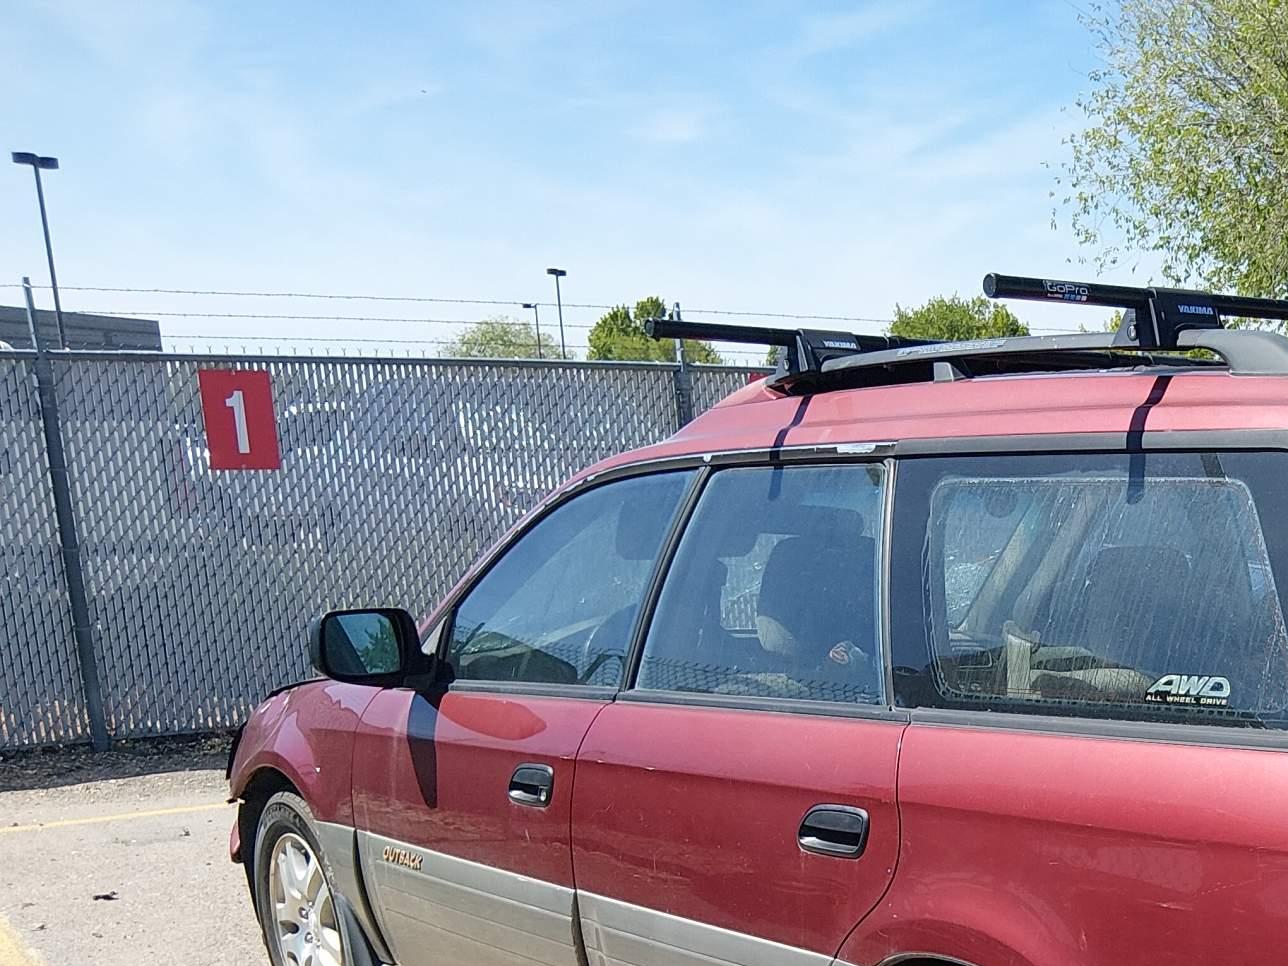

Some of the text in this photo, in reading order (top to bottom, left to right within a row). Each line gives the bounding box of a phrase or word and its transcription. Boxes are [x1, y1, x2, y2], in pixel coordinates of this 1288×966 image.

[1046, 282, 1089, 295] GoPro
[1177, 305, 1214, 315] YAKIMA
[823, 340, 857, 350] YAKIMA
[225, 390, 250, 454] 1
[1147, 675, 1231, 697] AWD
[1166, 696, 1197, 704] WHEEL
[1200, 697, 1228, 706] DRIVE
[383, 845, 424, 870] OUTBACK
